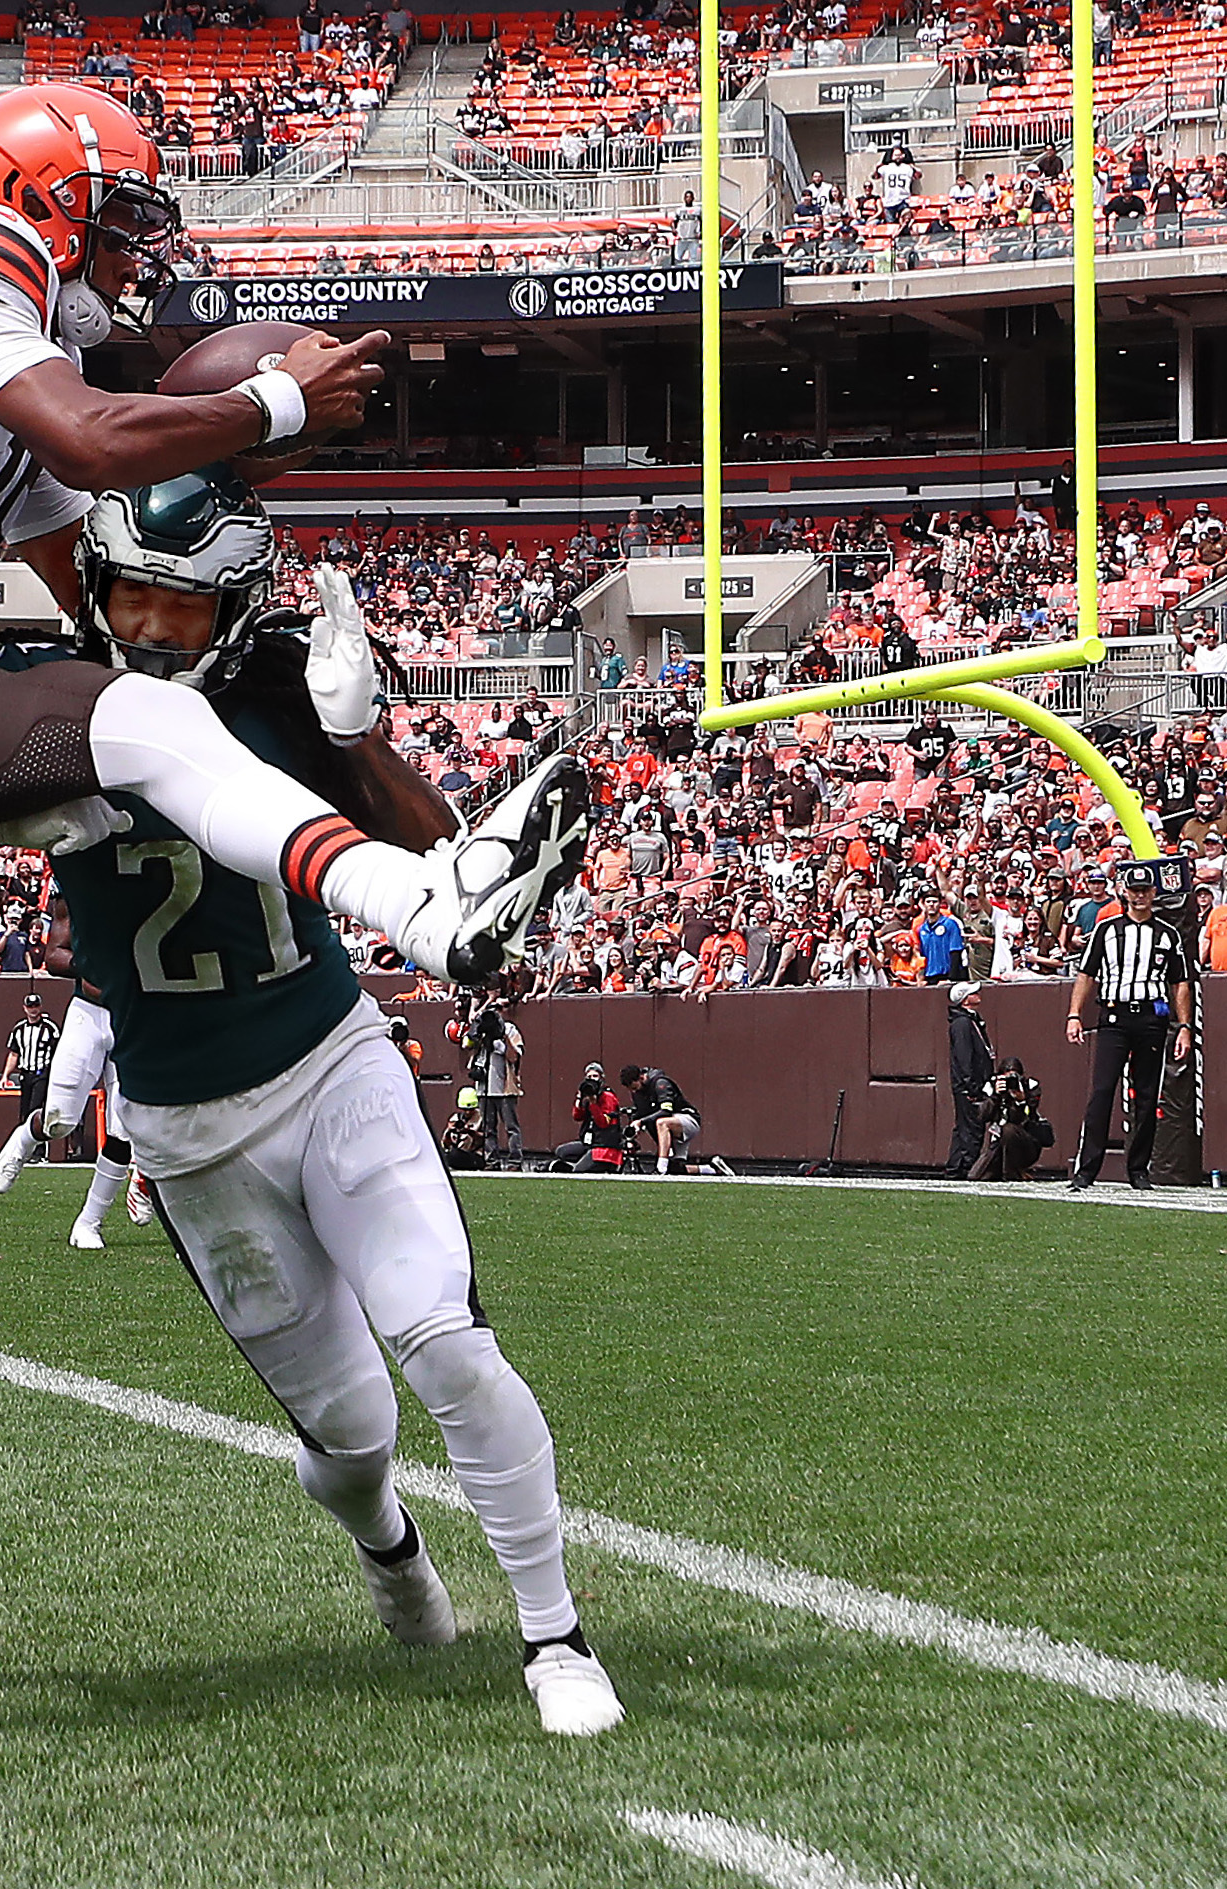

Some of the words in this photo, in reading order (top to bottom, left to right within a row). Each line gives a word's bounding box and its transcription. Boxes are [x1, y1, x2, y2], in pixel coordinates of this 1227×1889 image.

[887, 173, 907, 189] 85
[234, 281, 429, 303] CROSSCOUNTRY
[553, 269, 744, 297] CROSSCOUNRY
[887, 645, 902, 664] 91
[1165, 777, 1184, 800] 13
[117, 840, 312, 992] 21
